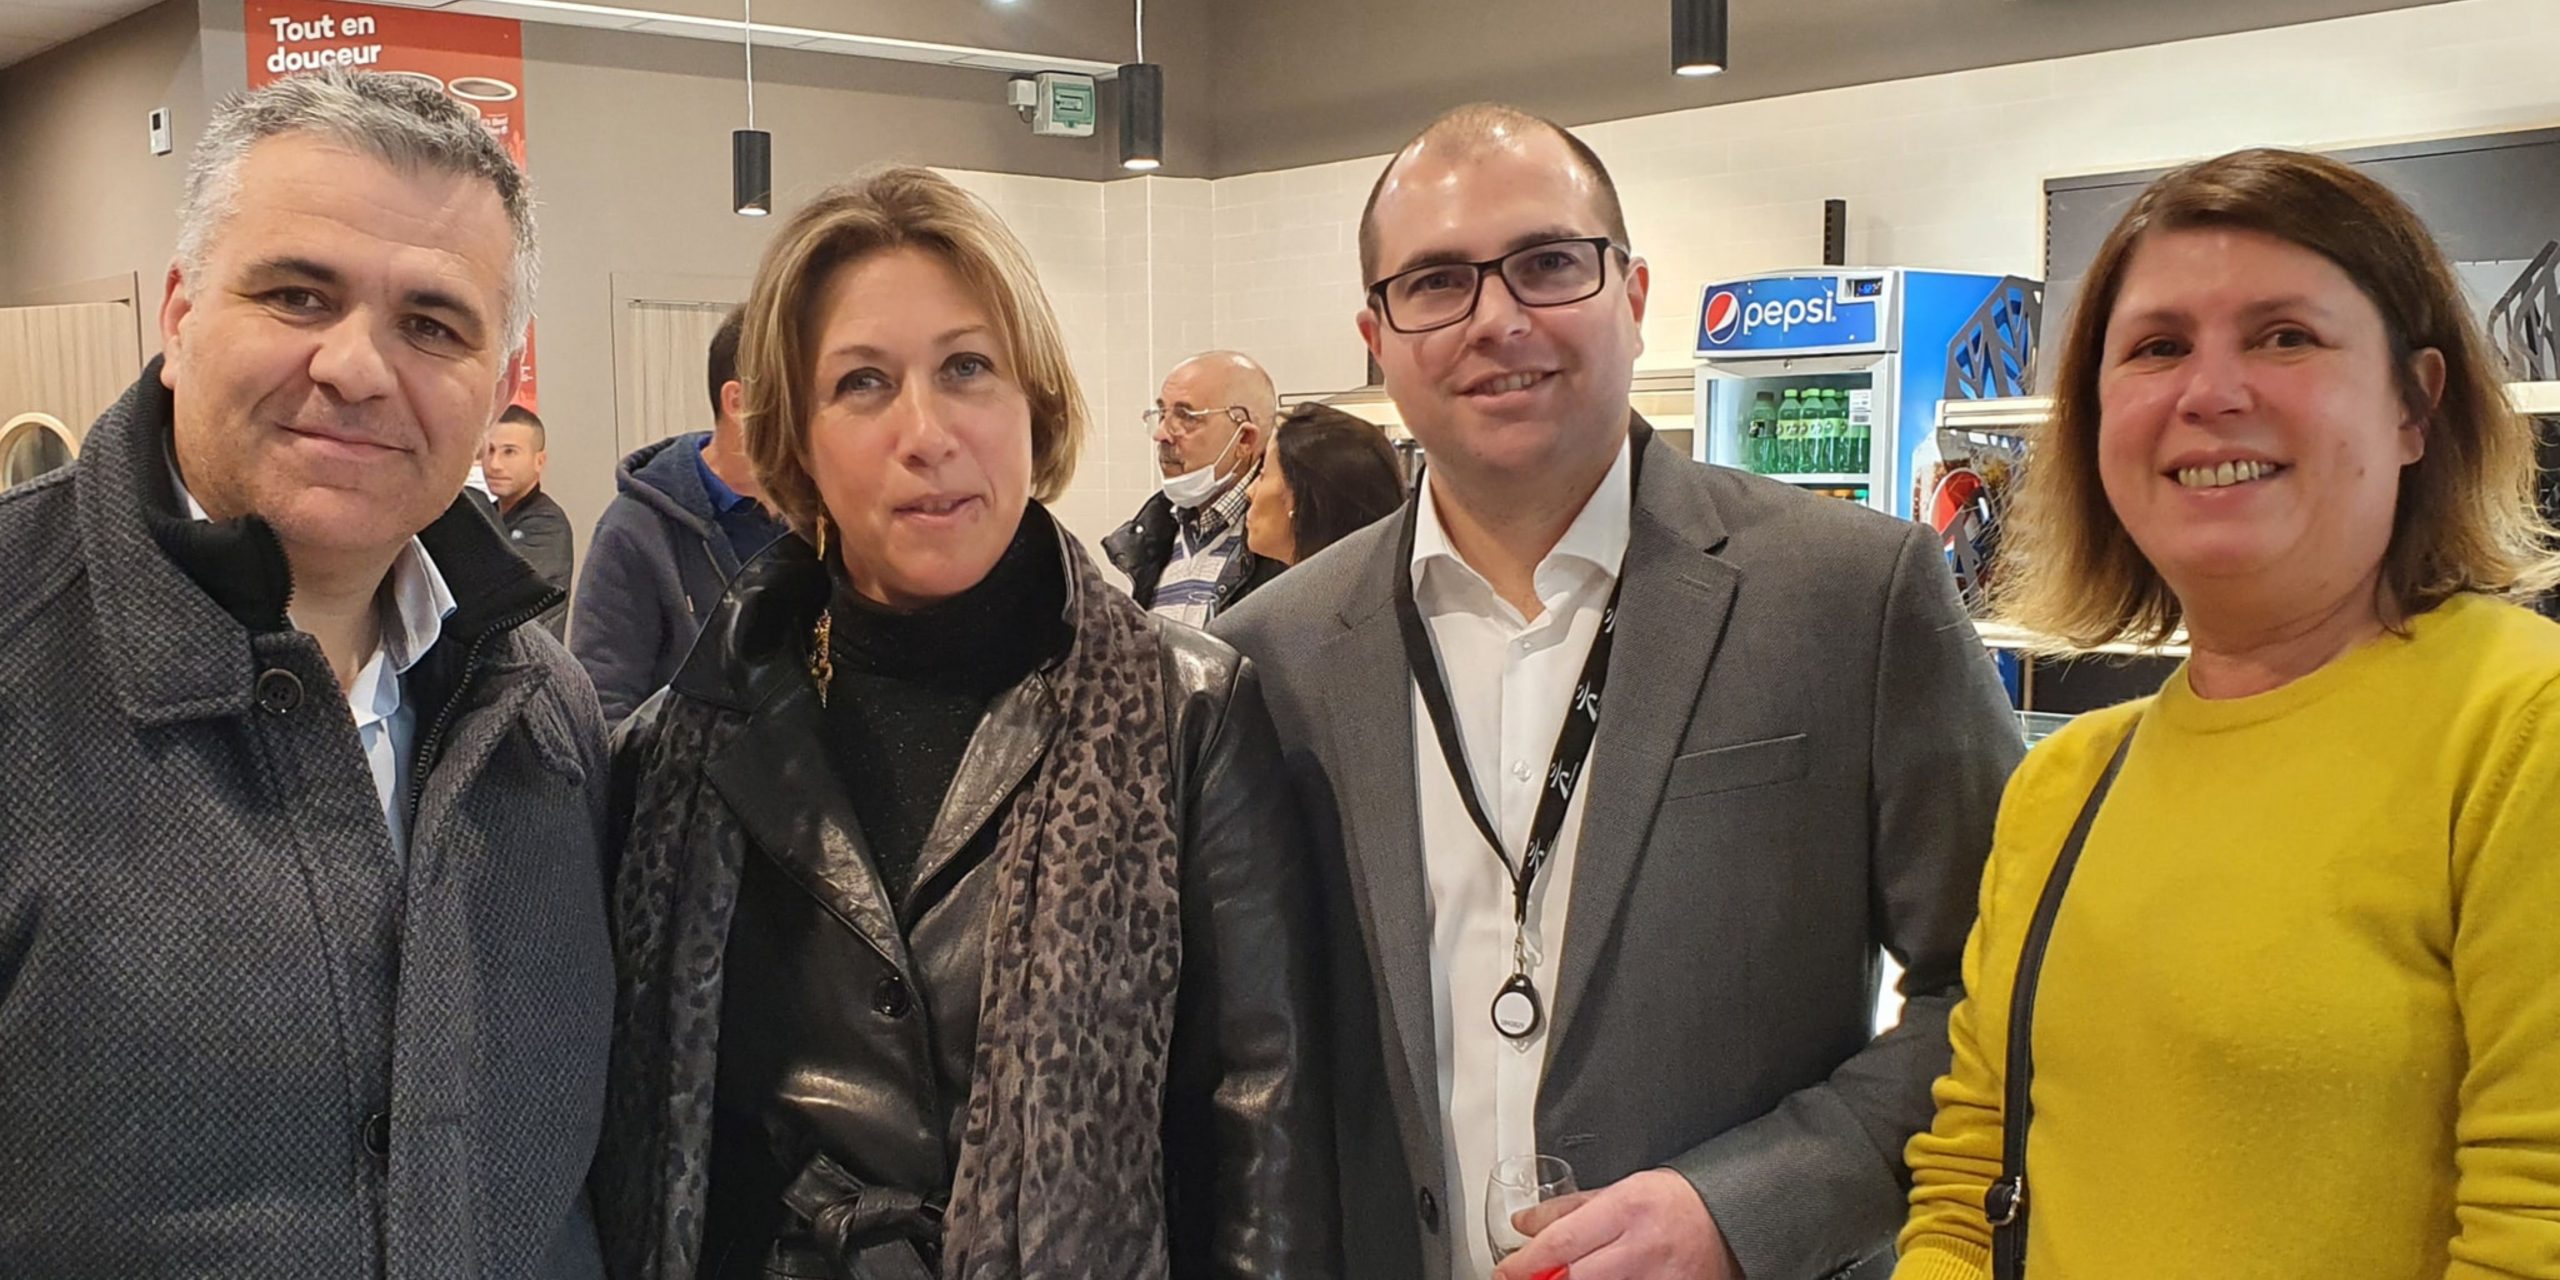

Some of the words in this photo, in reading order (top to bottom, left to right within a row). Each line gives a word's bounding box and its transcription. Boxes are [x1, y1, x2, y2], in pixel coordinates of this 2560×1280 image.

[269, 14, 335, 42] Tout
[341, 16, 375, 36] en
[266, 44, 382, 72] douceur
[1743, 291, 1837, 335] pepsi
